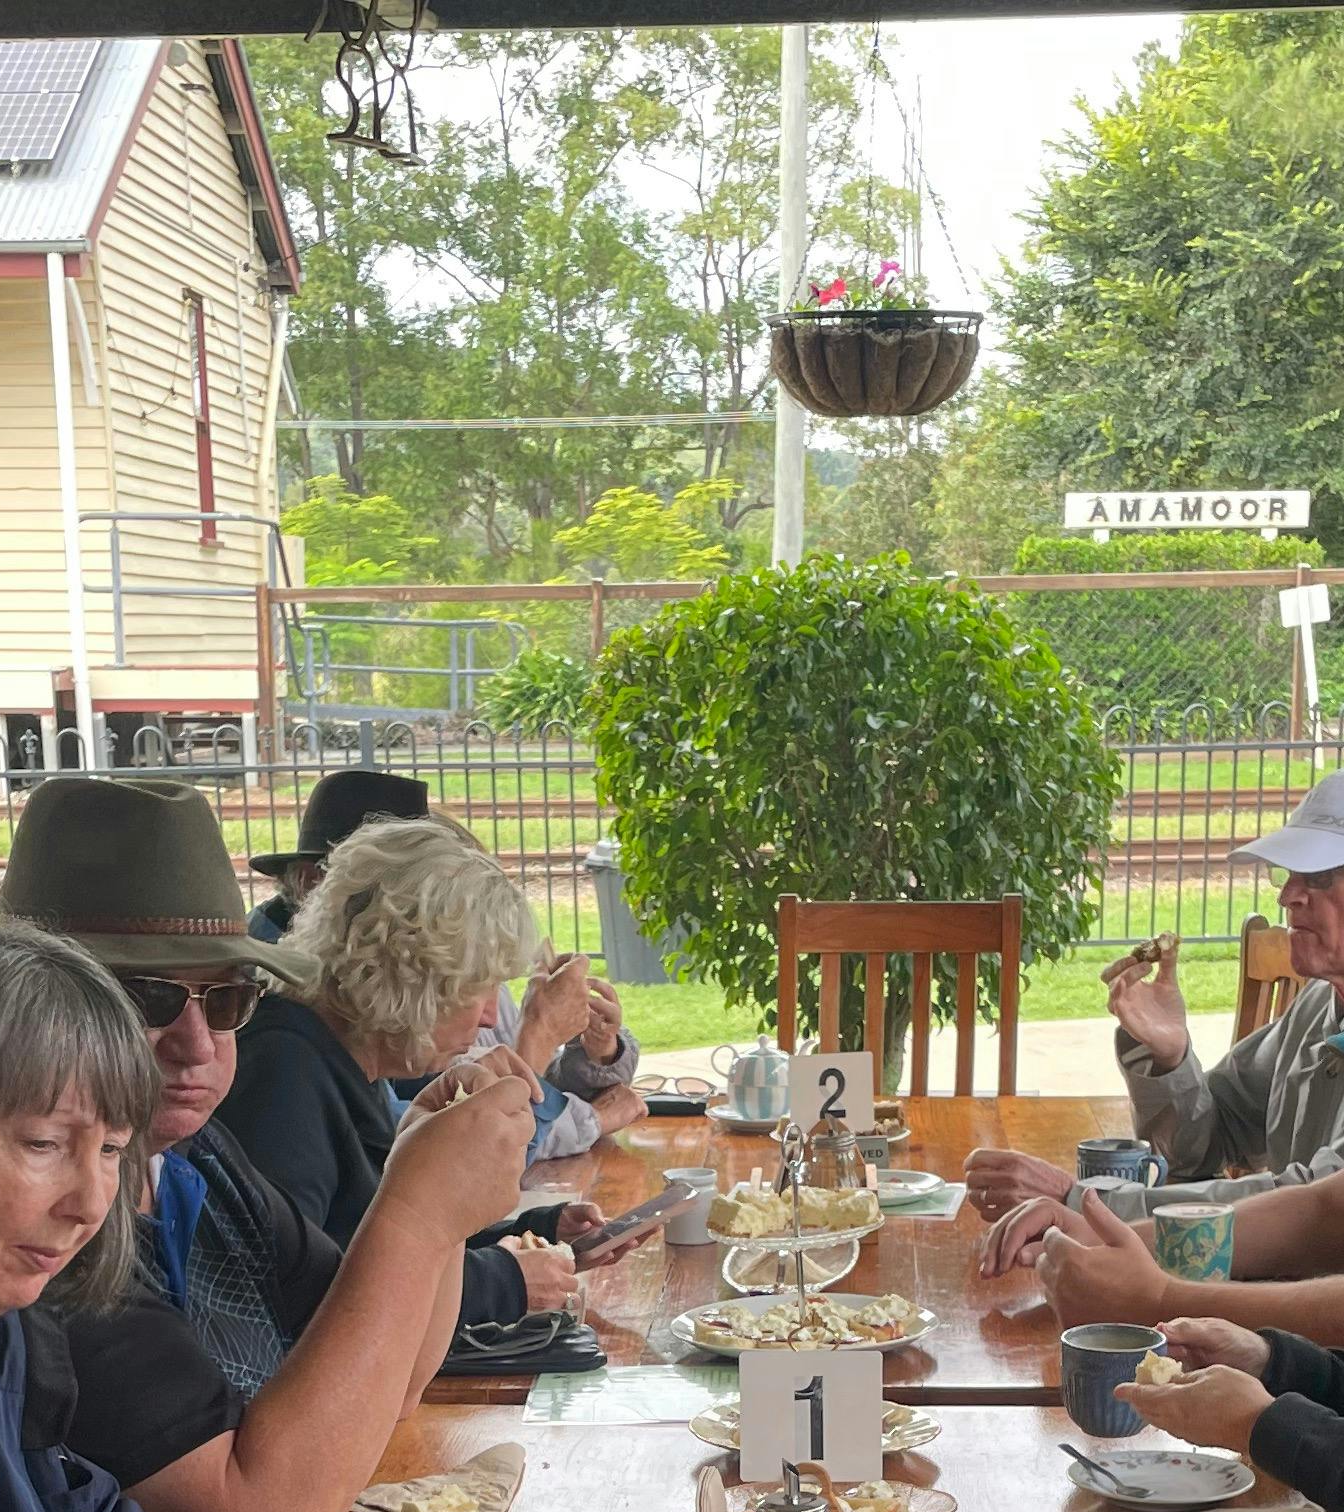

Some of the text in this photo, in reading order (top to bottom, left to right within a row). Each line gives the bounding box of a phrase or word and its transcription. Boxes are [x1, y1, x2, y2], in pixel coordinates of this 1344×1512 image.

[1088, 496, 1287, 522] AMAMOOR
[819, 1067, 846, 1119] 2
[794, 1375, 824, 1461] 1
